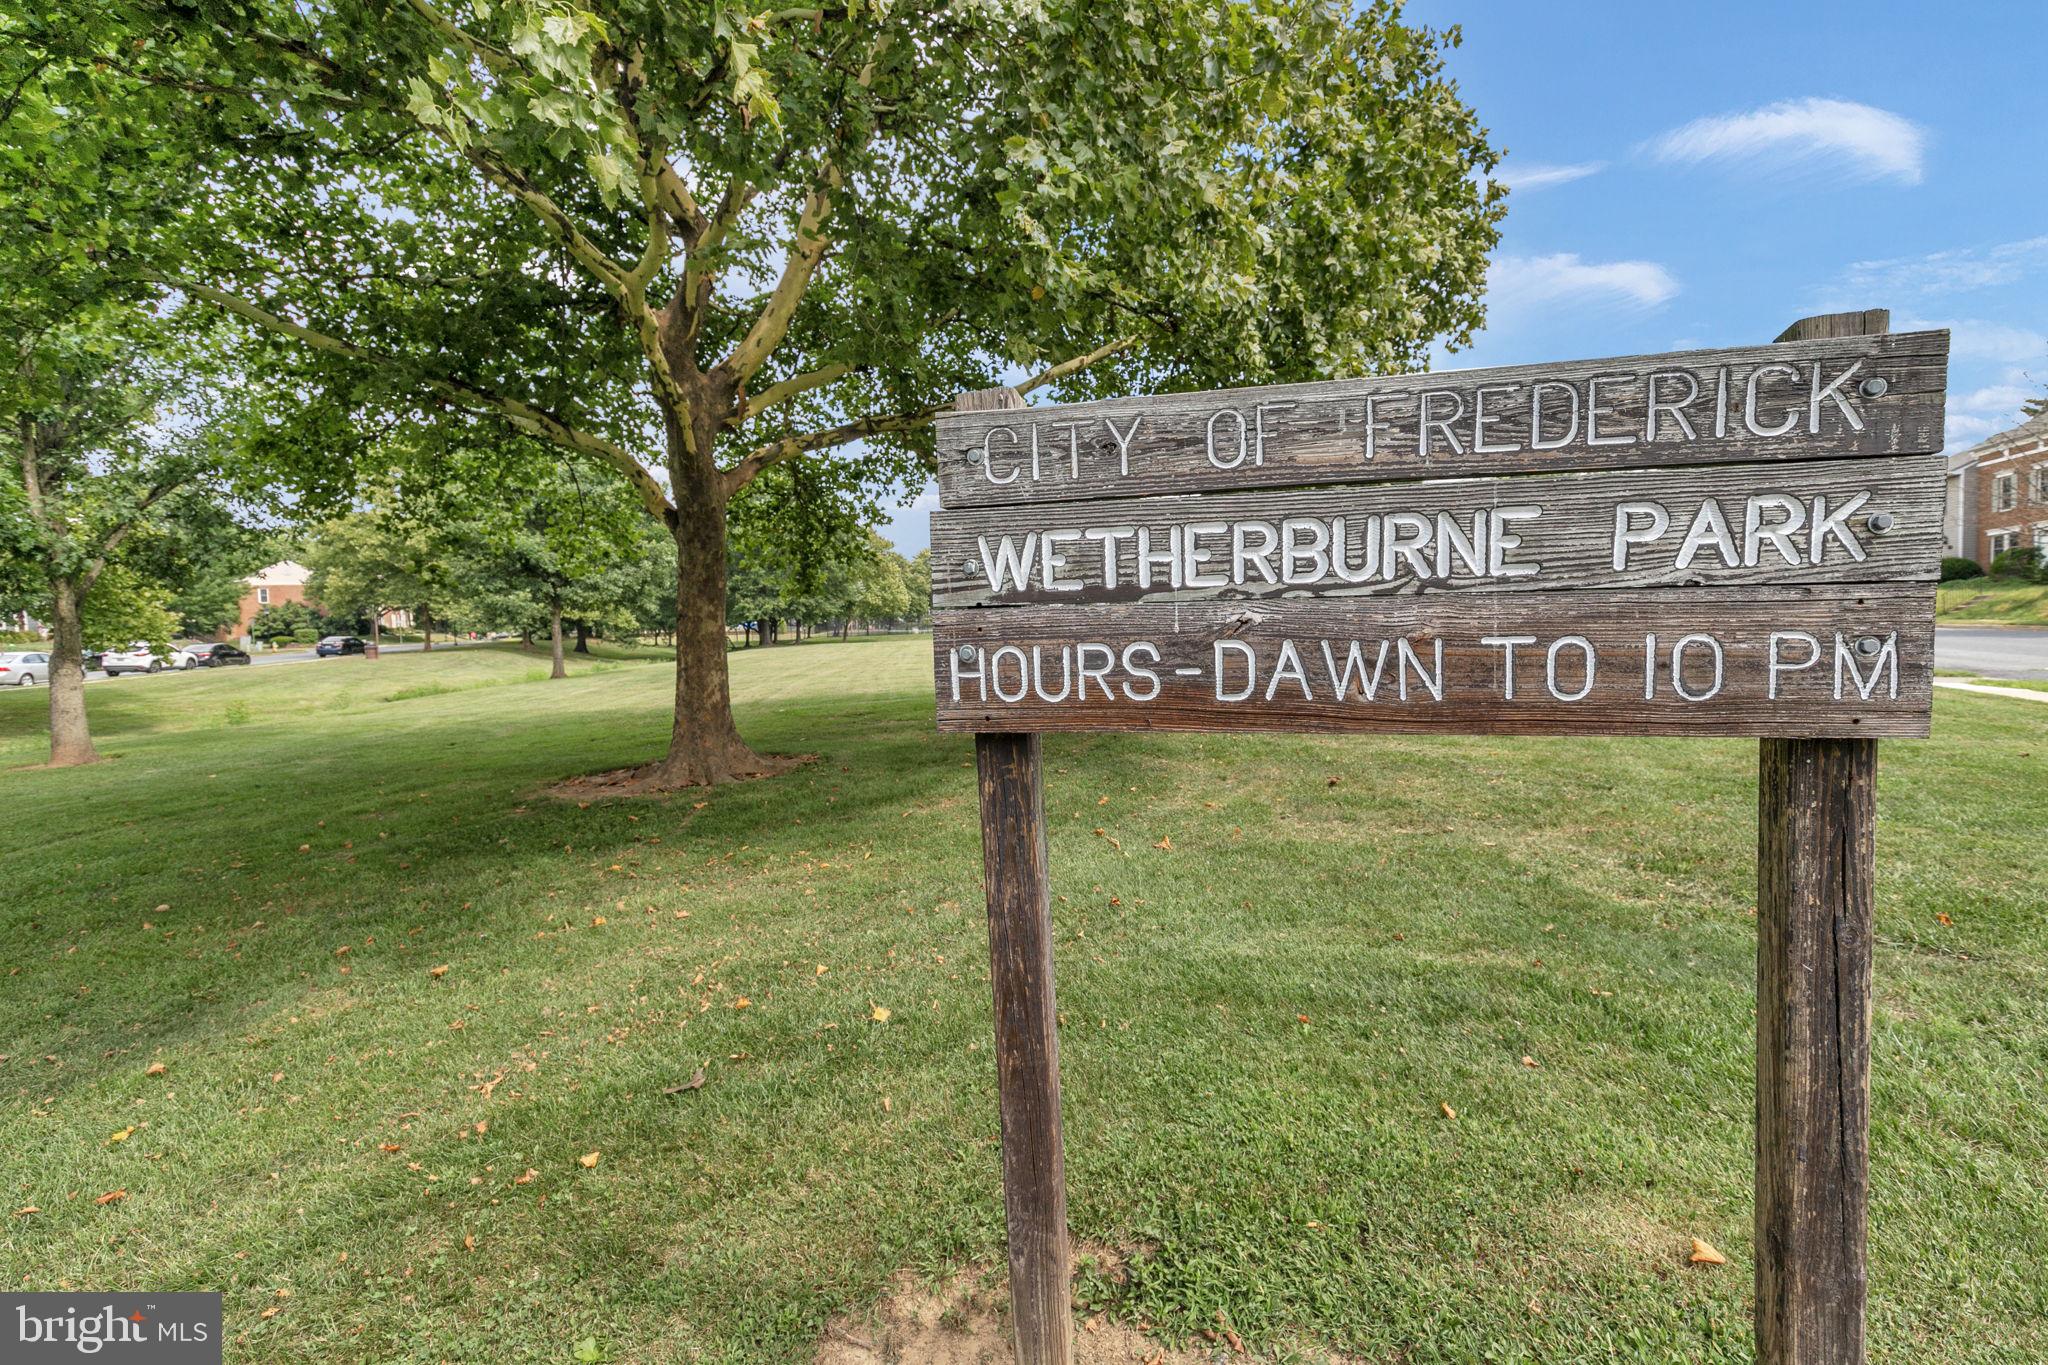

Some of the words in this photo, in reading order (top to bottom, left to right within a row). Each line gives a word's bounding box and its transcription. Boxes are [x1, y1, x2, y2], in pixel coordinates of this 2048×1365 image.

[983, 416, 1141, 484] CITY
[1206, 403, 1296, 469] OF
[1365, 360, 1865, 459] FREDERICK
[977, 504, 1543, 592] WETHERBURNE
[1612, 490, 1871, 571] PARK
[1480, 635, 1596, 701] TO
[1645, 632, 1723, 701] 10
[1768, 630, 1898, 700] PM
